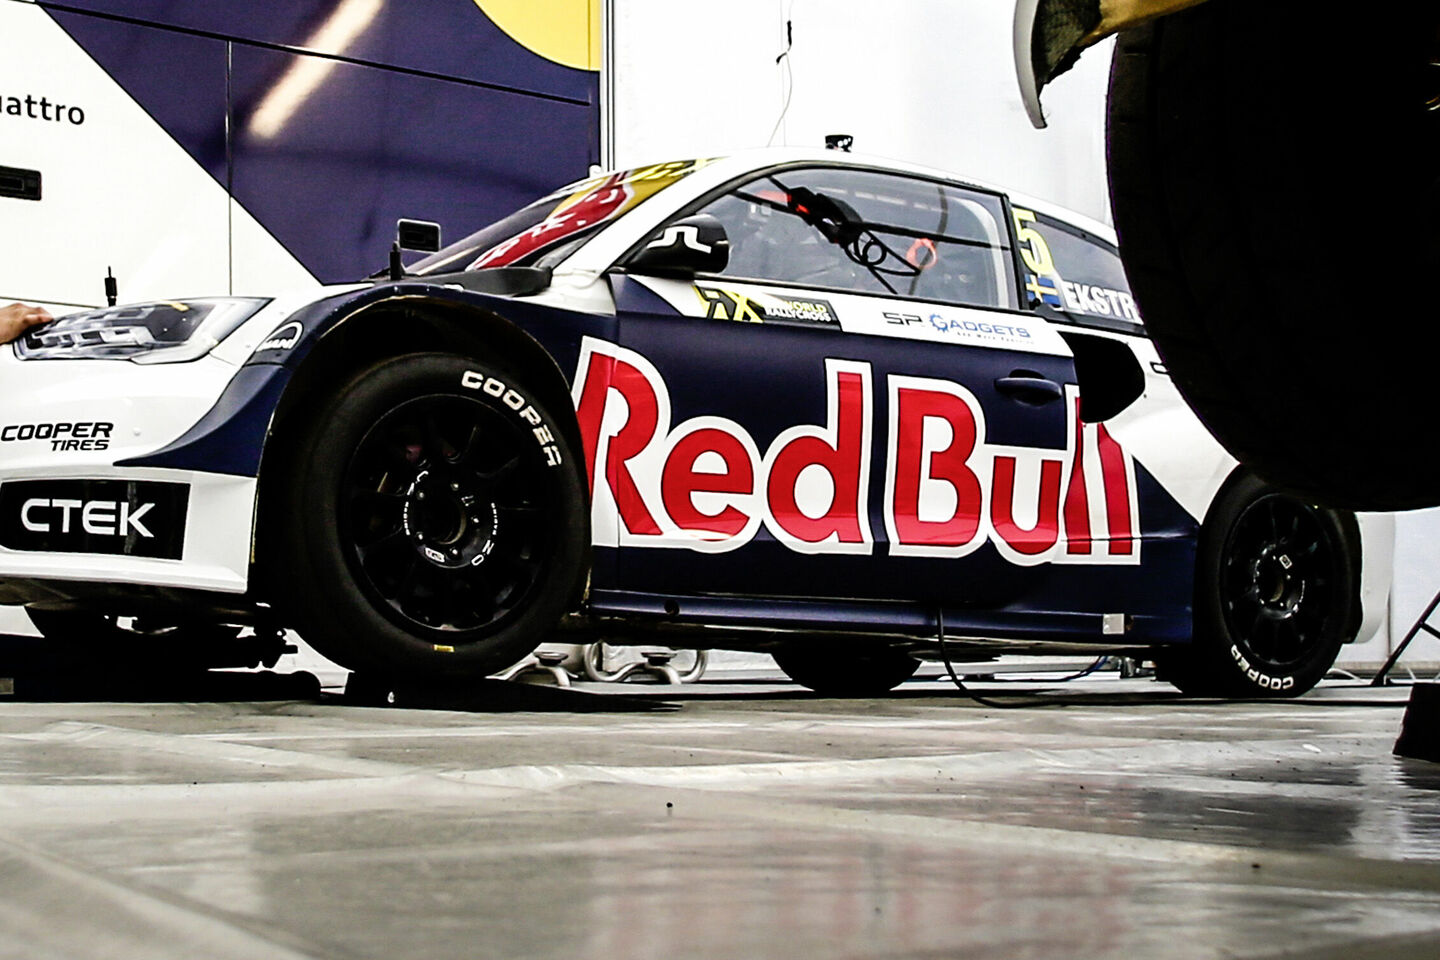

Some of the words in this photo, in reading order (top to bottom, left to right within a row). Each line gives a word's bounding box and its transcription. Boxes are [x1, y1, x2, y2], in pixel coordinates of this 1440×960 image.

[0, 422, 114, 442] COOPER
[461, 370, 562, 467] COOPER
[50, 440, 109, 452] TIRES
[572, 336, 872, 555] Red
[888, 374, 1141, 565] Bull
[21, 498, 156, 538] CTEK
[1231, 644, 1294, 691] COOPER
